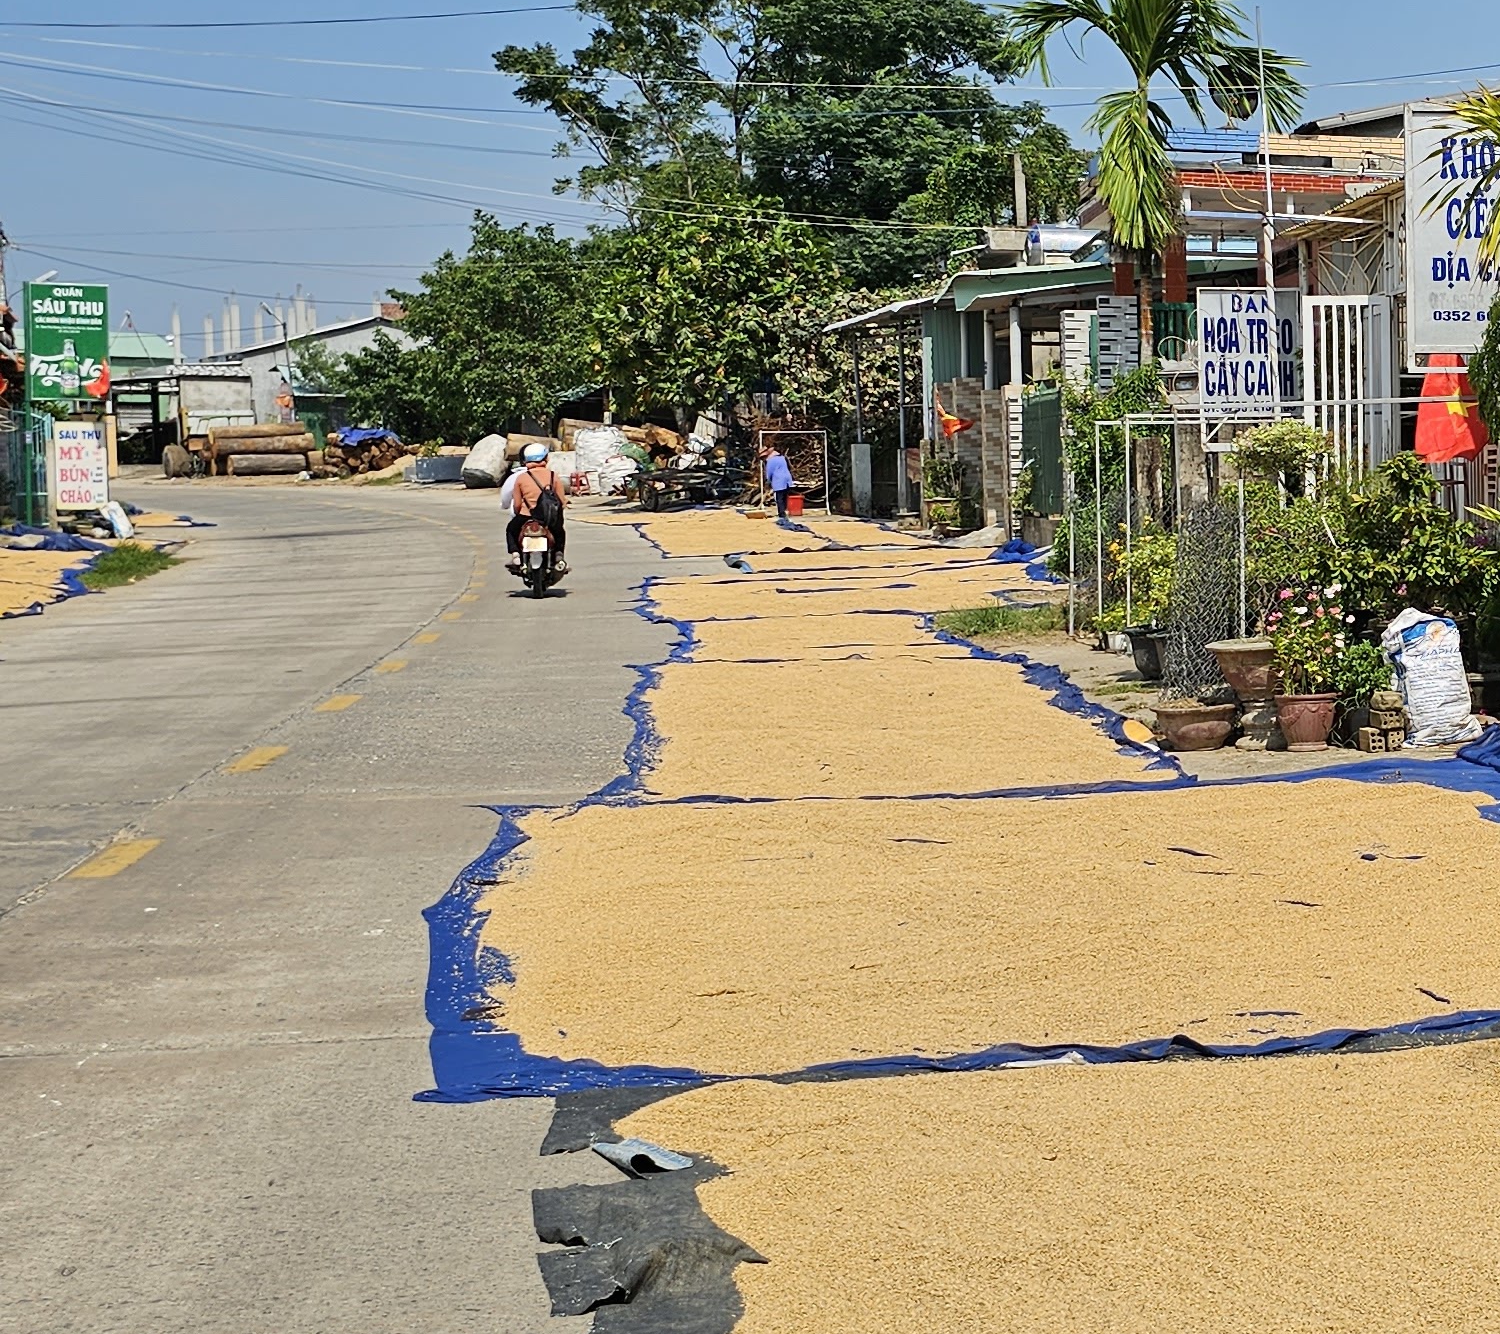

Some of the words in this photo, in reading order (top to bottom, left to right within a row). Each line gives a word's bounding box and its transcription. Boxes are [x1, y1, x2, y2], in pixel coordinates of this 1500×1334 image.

[1431, 250, 1470, 289] ĐỊA
[32, 297, 66, 314] SÁU
[68, 300, 104, 316] THU
[1433, 310, 1471, 321] 0352
[1203, 317, 1240, 353] HOA
[1246, 318, 1293, 355] TRO
[1205, 354, 1239, 396] CÂY
[81, 430, 102, 440] THU
[59, 464, 90, 482] BÚN
[60, 485, 92, 503] CHÁO
